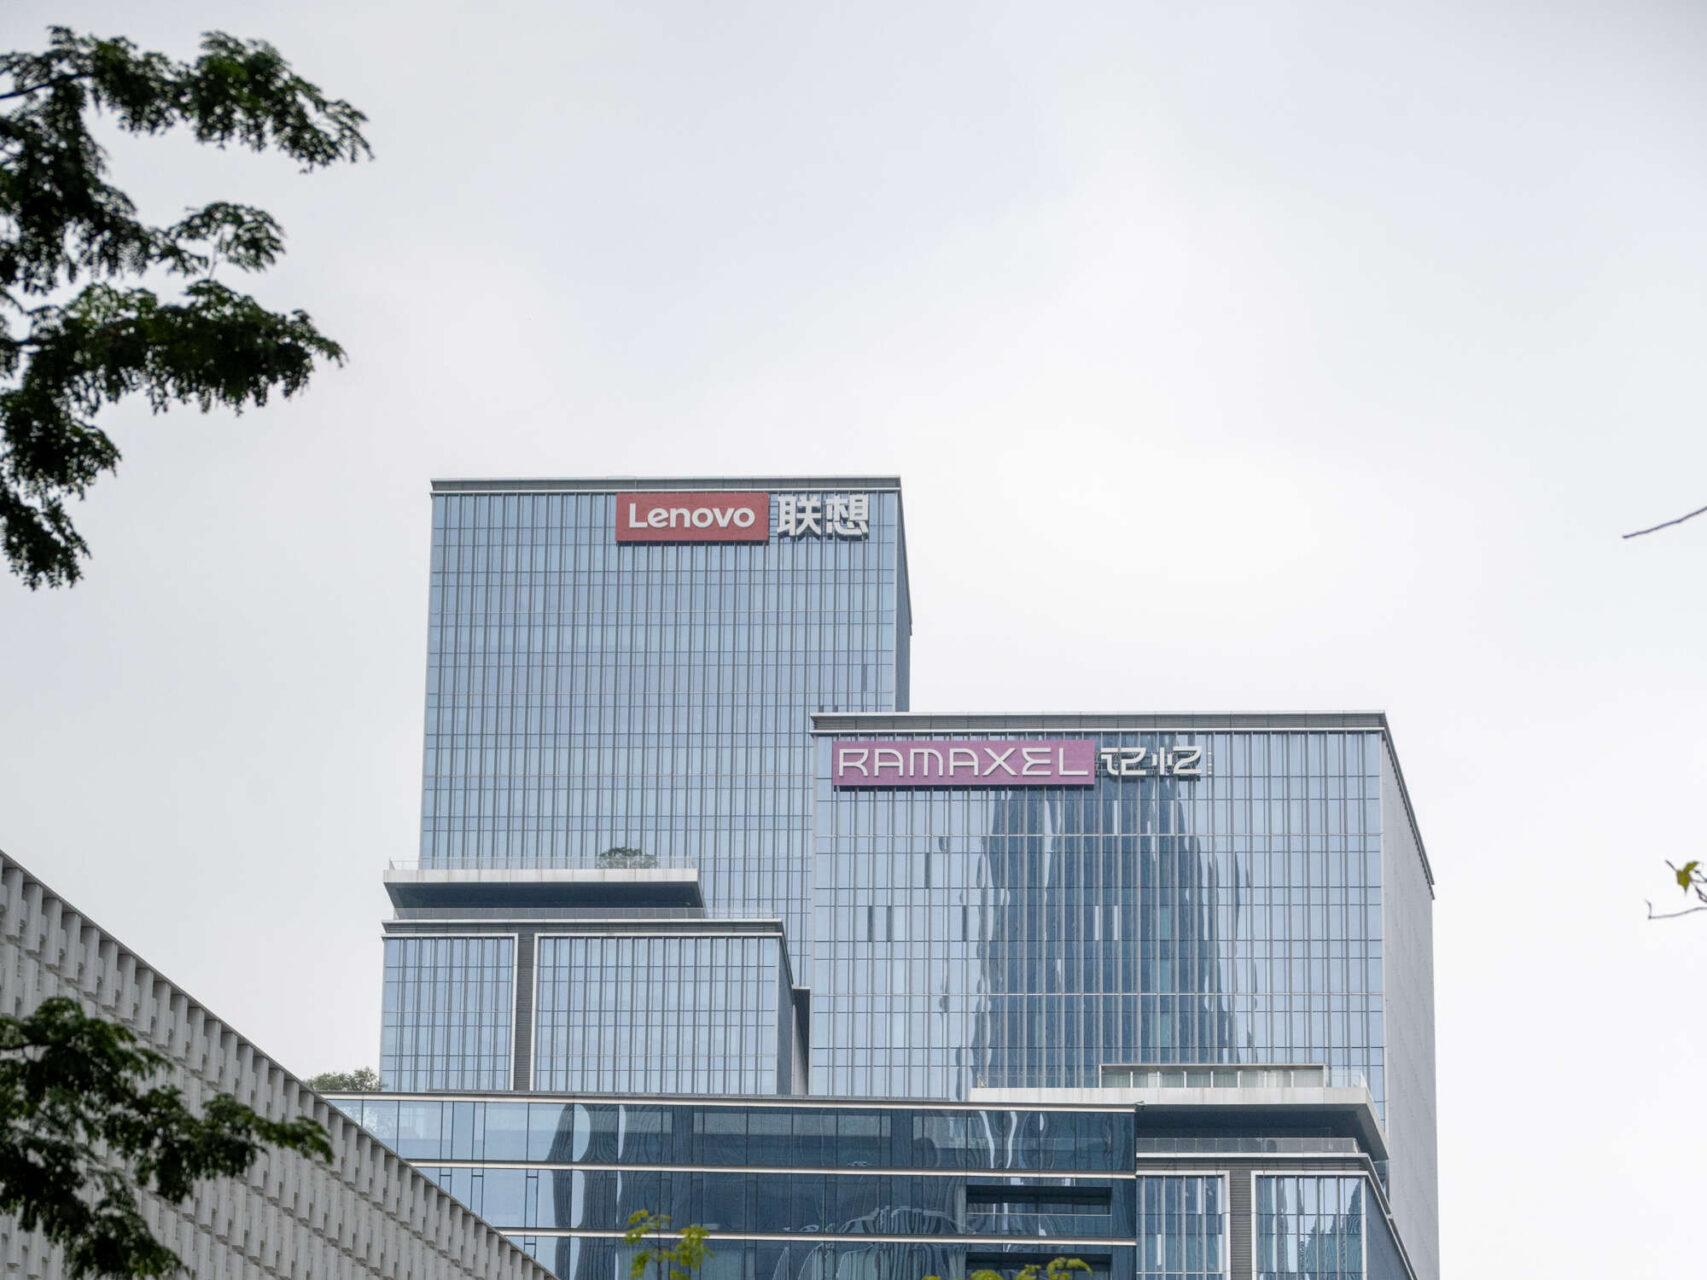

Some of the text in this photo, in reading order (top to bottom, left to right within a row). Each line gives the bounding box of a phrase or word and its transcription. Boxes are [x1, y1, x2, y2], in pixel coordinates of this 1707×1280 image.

[628, 502, 756, 529] Lenovo
[776, 493, 869, 541] 联想
[838, 747, 1089, 777] RAMAXEL
